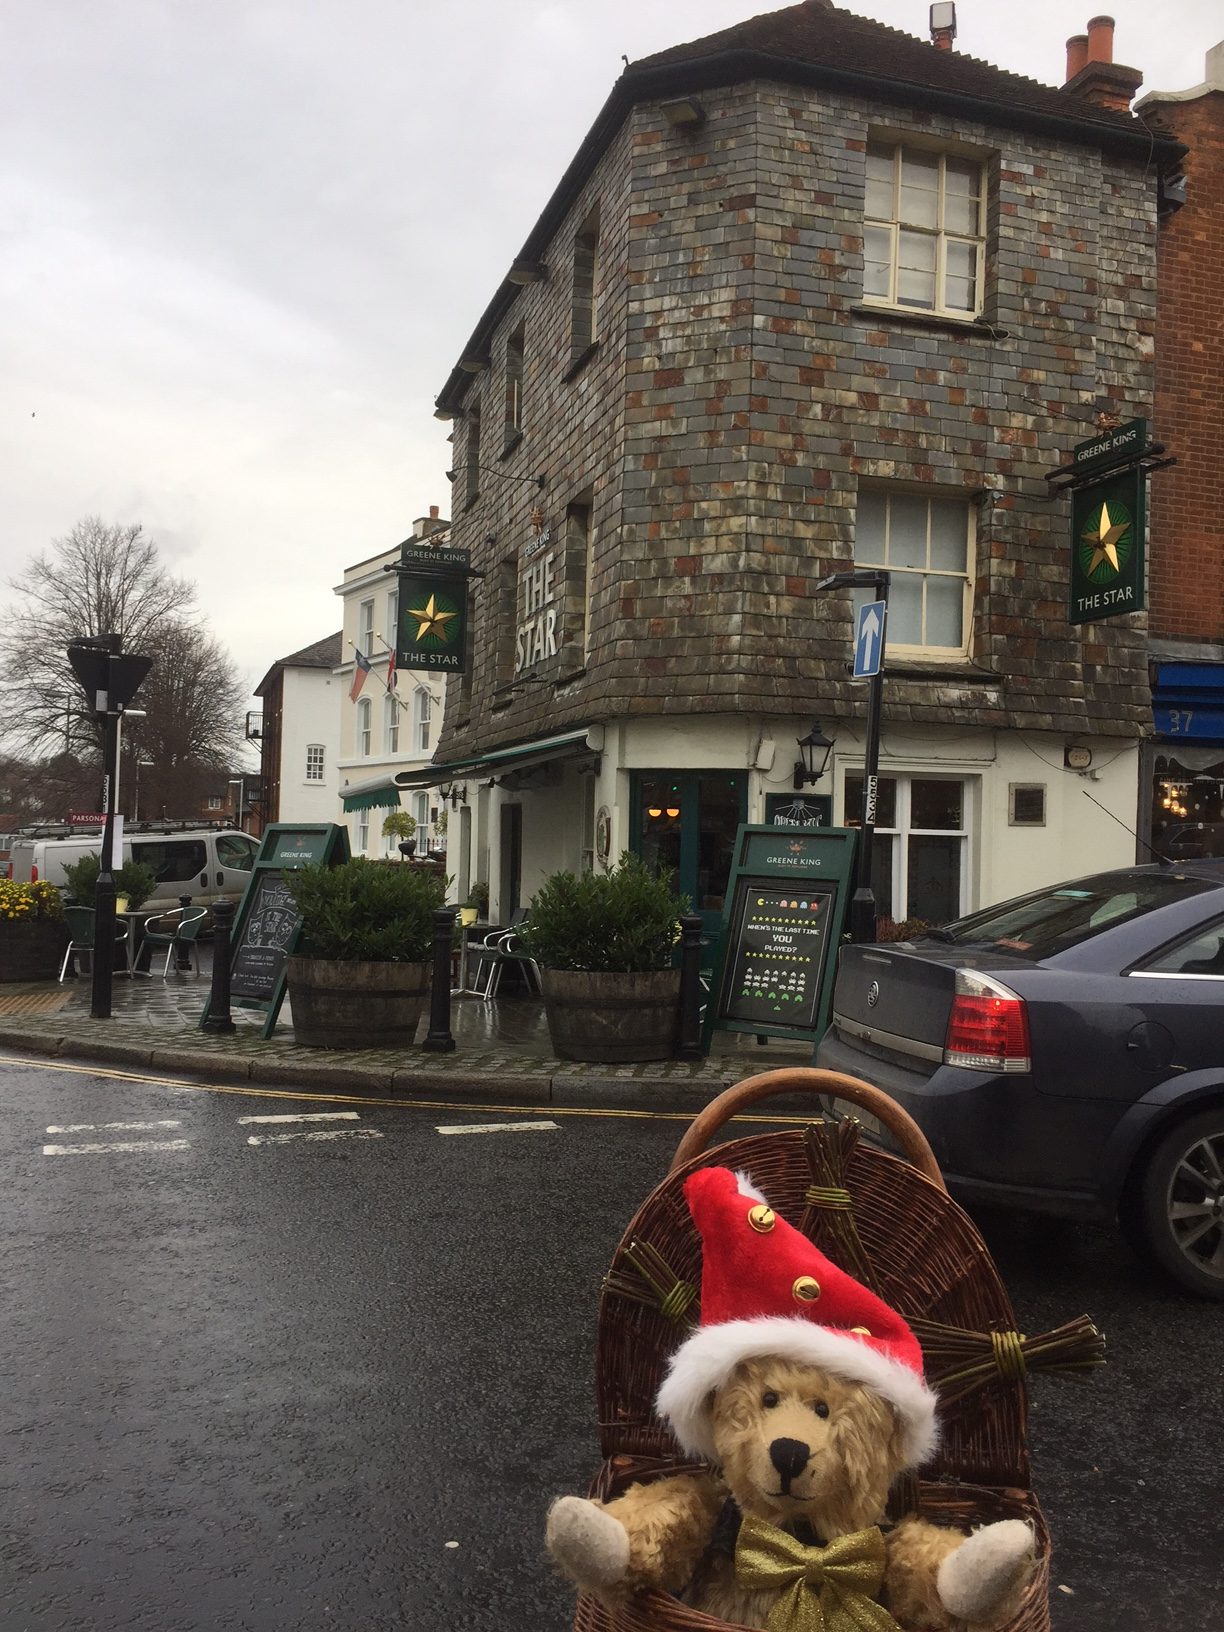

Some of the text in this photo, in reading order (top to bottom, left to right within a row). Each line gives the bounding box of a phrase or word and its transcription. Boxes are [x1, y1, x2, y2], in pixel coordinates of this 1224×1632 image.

[1077, 430, 1136, 461] GREENE KING
[540, 529, 550, 545] KING
[406, 550, 466, 562] GREENE KING
[523, 552, 554, 617] THE
[1077, 586, 1133, 612] THE STAR
[515, 609, 557, 673] STAR
[402, 652, 458, 665] THE STAR
[1168, 709, 1193, 733] 37
[867, 776, 877, 822] 5534
[766, 856, 821, 866] GREENE KING
[764, 944, 798, 953] PLAYED?
[772, 934, 793, 943] YOU
